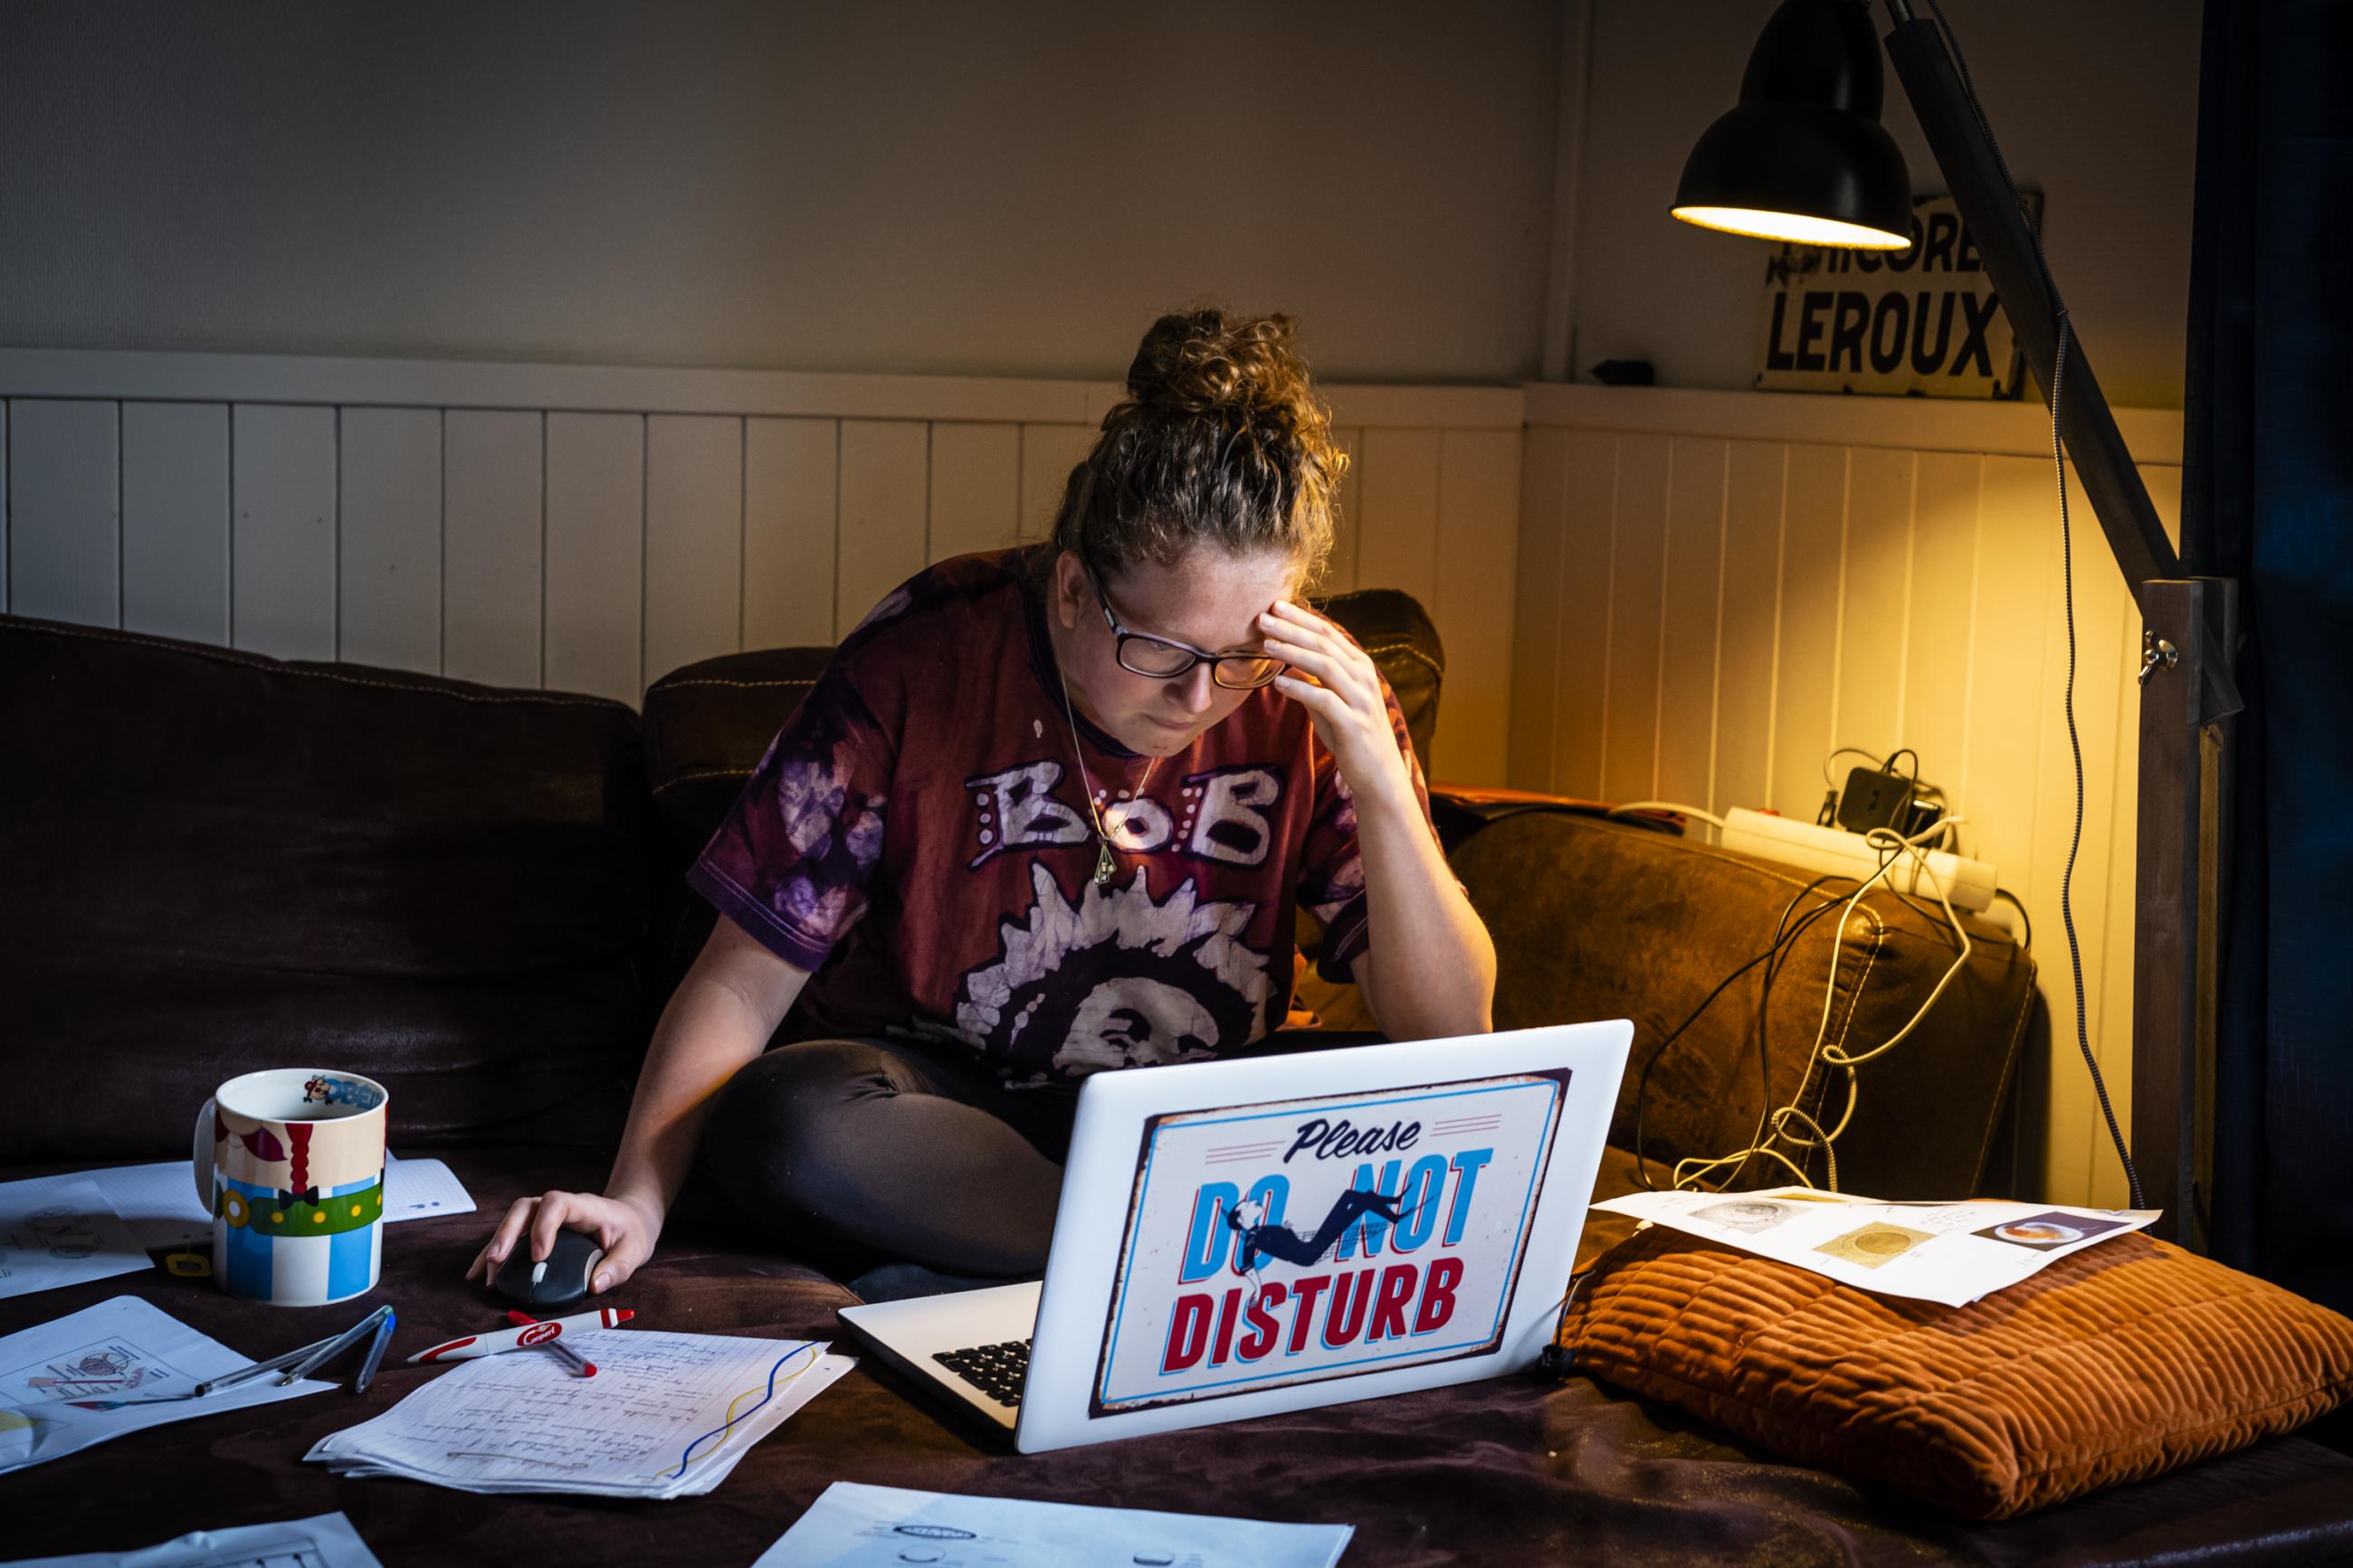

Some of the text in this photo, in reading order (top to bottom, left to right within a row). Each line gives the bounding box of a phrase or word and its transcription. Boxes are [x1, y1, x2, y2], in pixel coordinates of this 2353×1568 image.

[1767, 291, 2000, 377] LEROUX
[1283, 1118, 1421, 1164] Please
[1178, 1148, 1494, 1285] DO NOT
[1159, 1257, 1464, 1376] DISTURB
